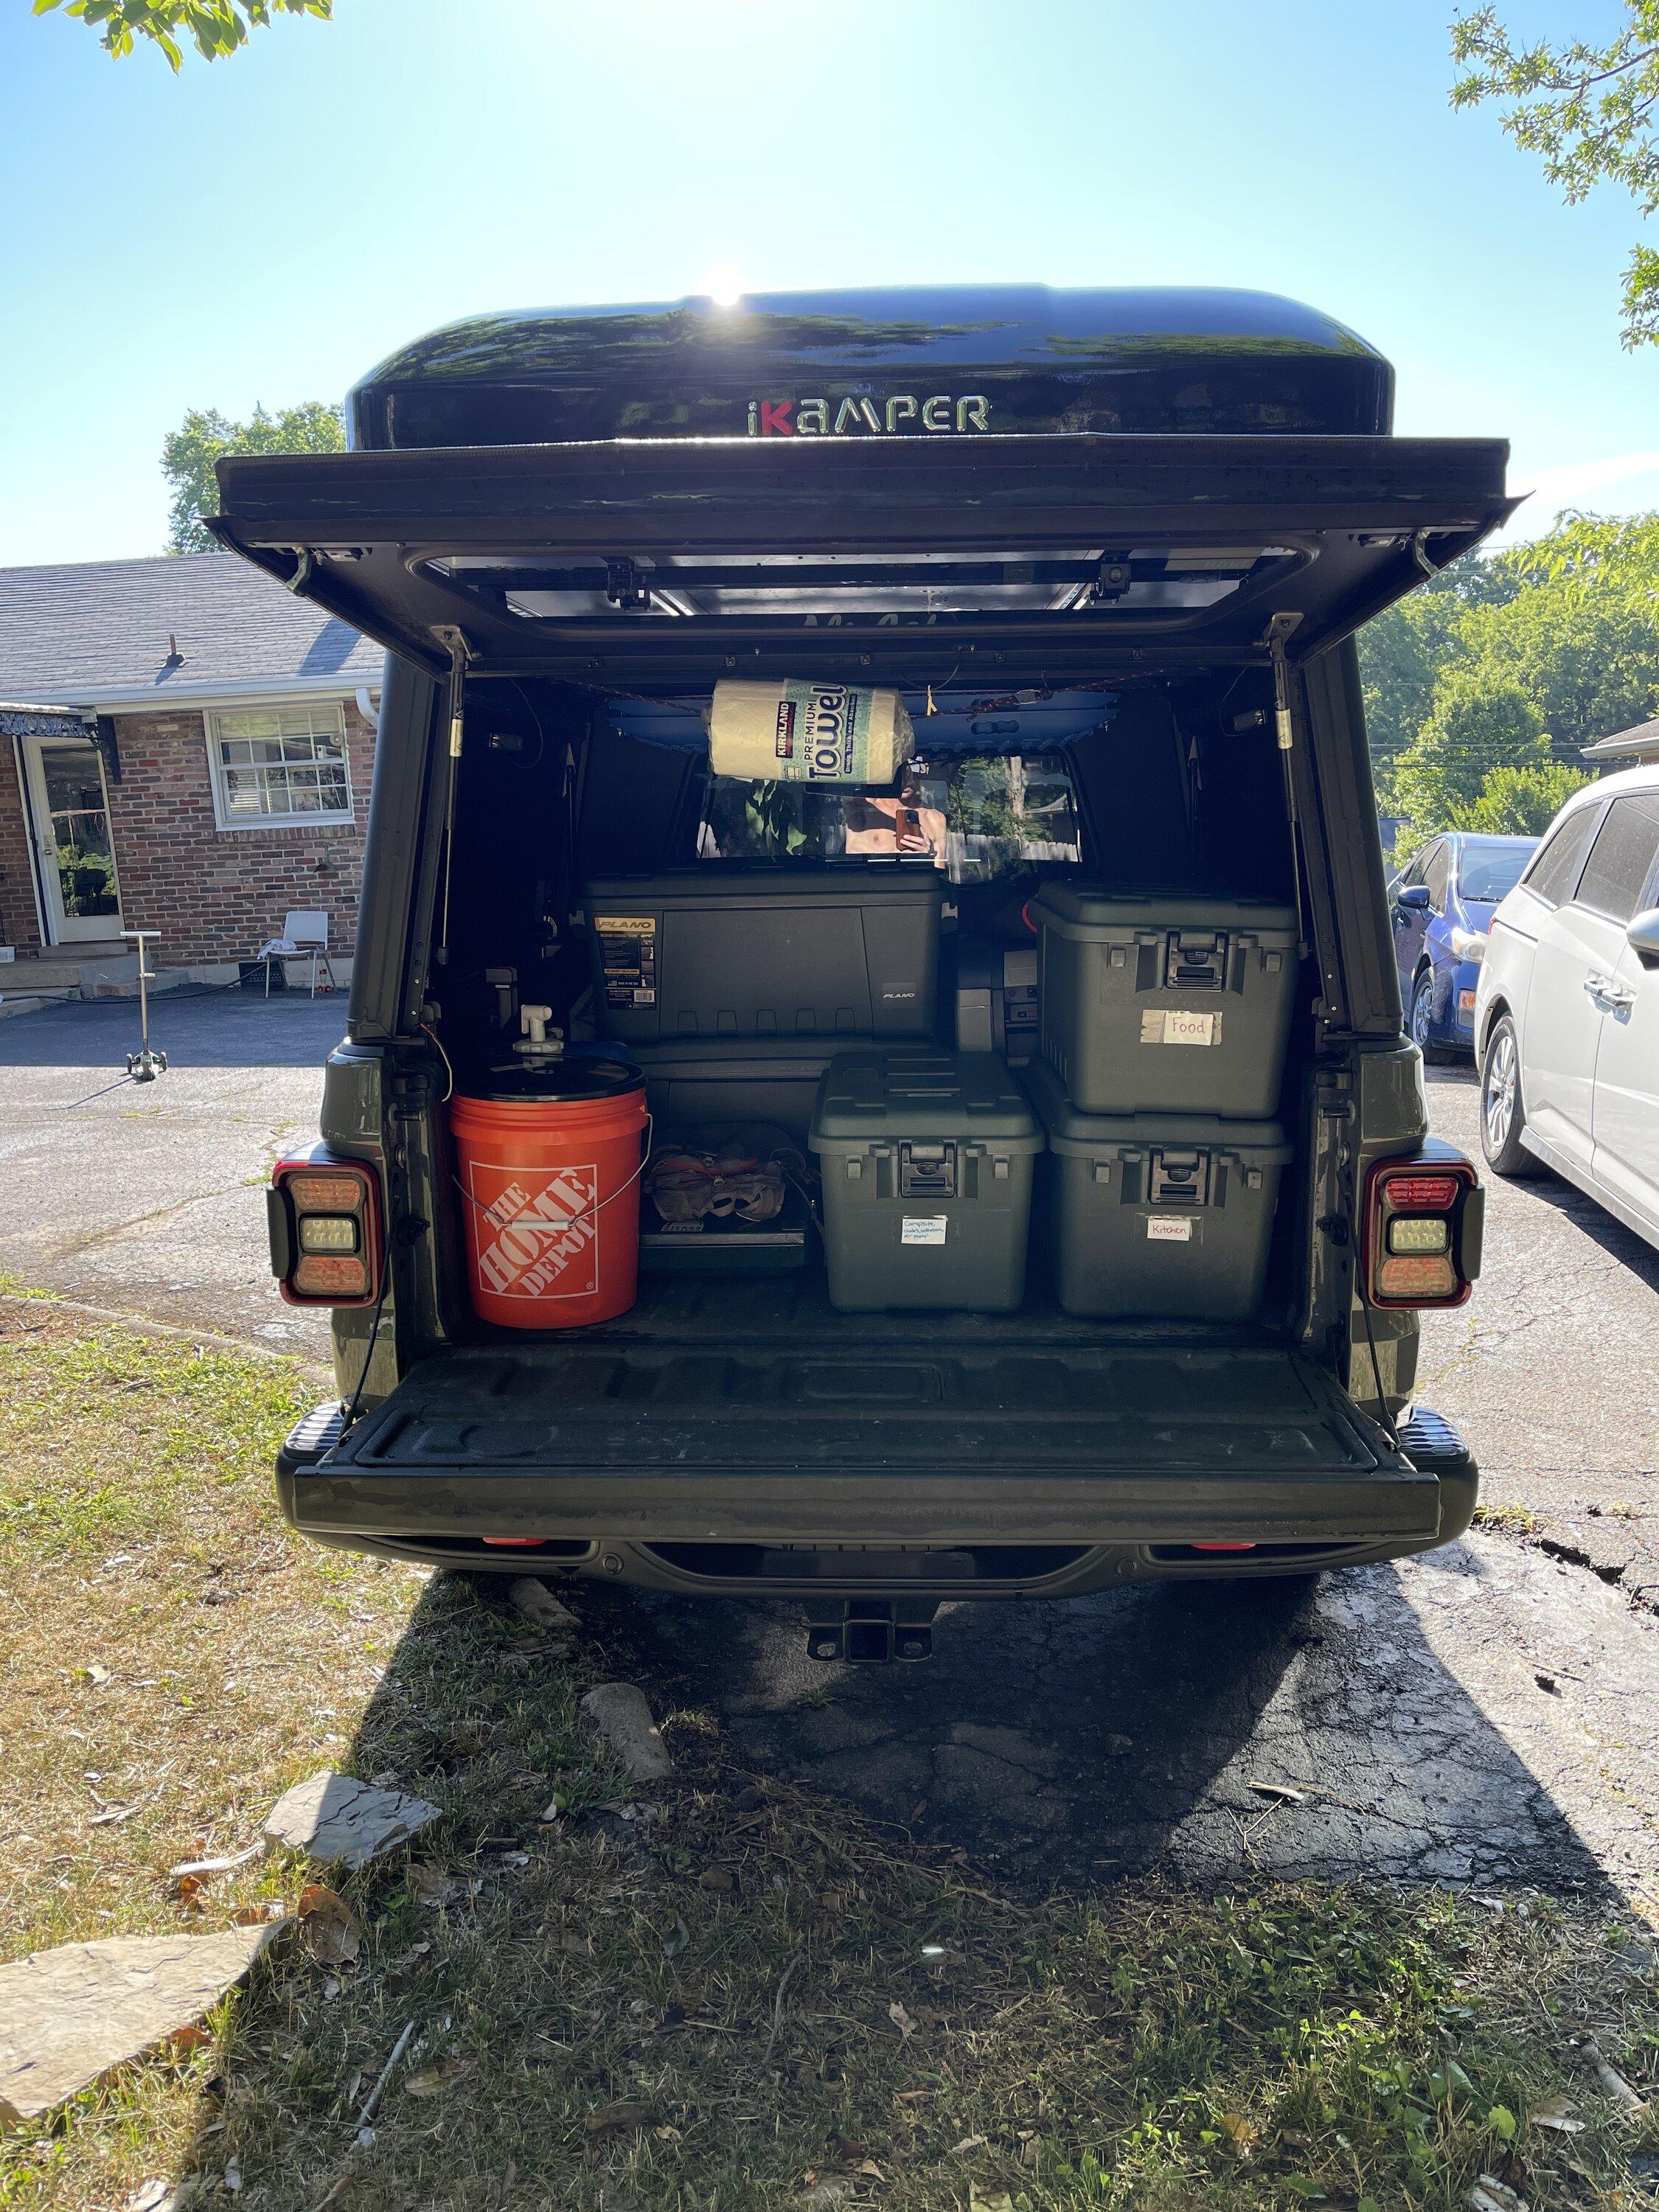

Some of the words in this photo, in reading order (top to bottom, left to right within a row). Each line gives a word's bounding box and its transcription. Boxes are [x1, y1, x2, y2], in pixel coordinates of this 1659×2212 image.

[777, 703, 789, 756] KIRKLAND
[804, 702, 817, 760] PREMIUM
[809, 686, 845, 779] Towel
[1172, 1017, 1205, 1034] Food
[479, 1169, 597, 1294] HOME
[483, 1182, 532, 1231] THE
[1152, 1224, 1187, 1234] Kitchen
[518, 1215, 597, 1297] DEPOT
